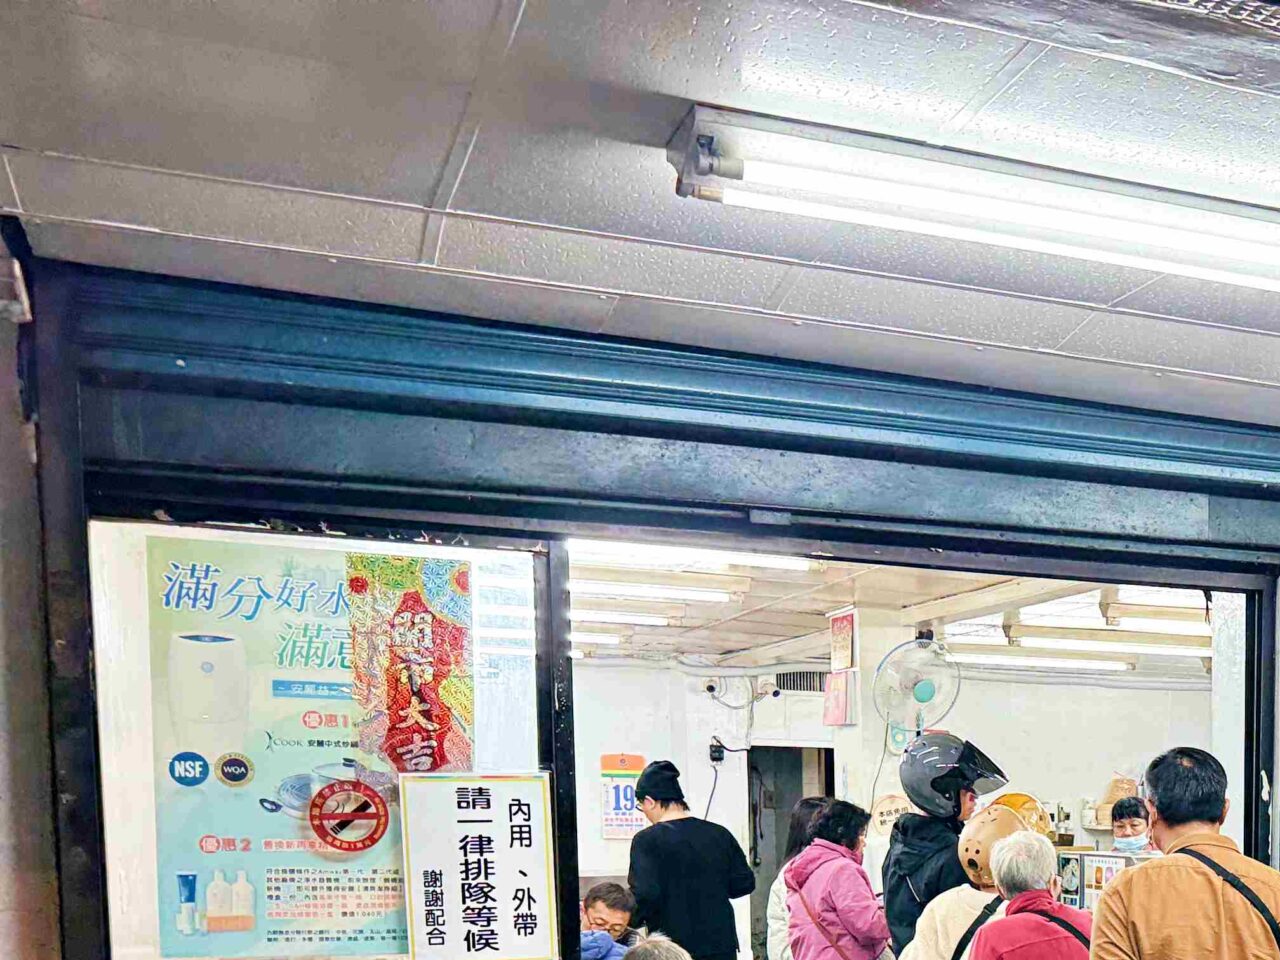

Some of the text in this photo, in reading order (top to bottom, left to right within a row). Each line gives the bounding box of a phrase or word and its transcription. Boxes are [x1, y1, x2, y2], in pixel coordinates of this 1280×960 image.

[174, 760, 203, 777] NSF
[223, 764, 247, 775] WQA
[613, 784, 635, 812] 19
[456, 786, 499, 952] 請一律排隊等候
[423, 869, 446, 946] 謝謝配合
